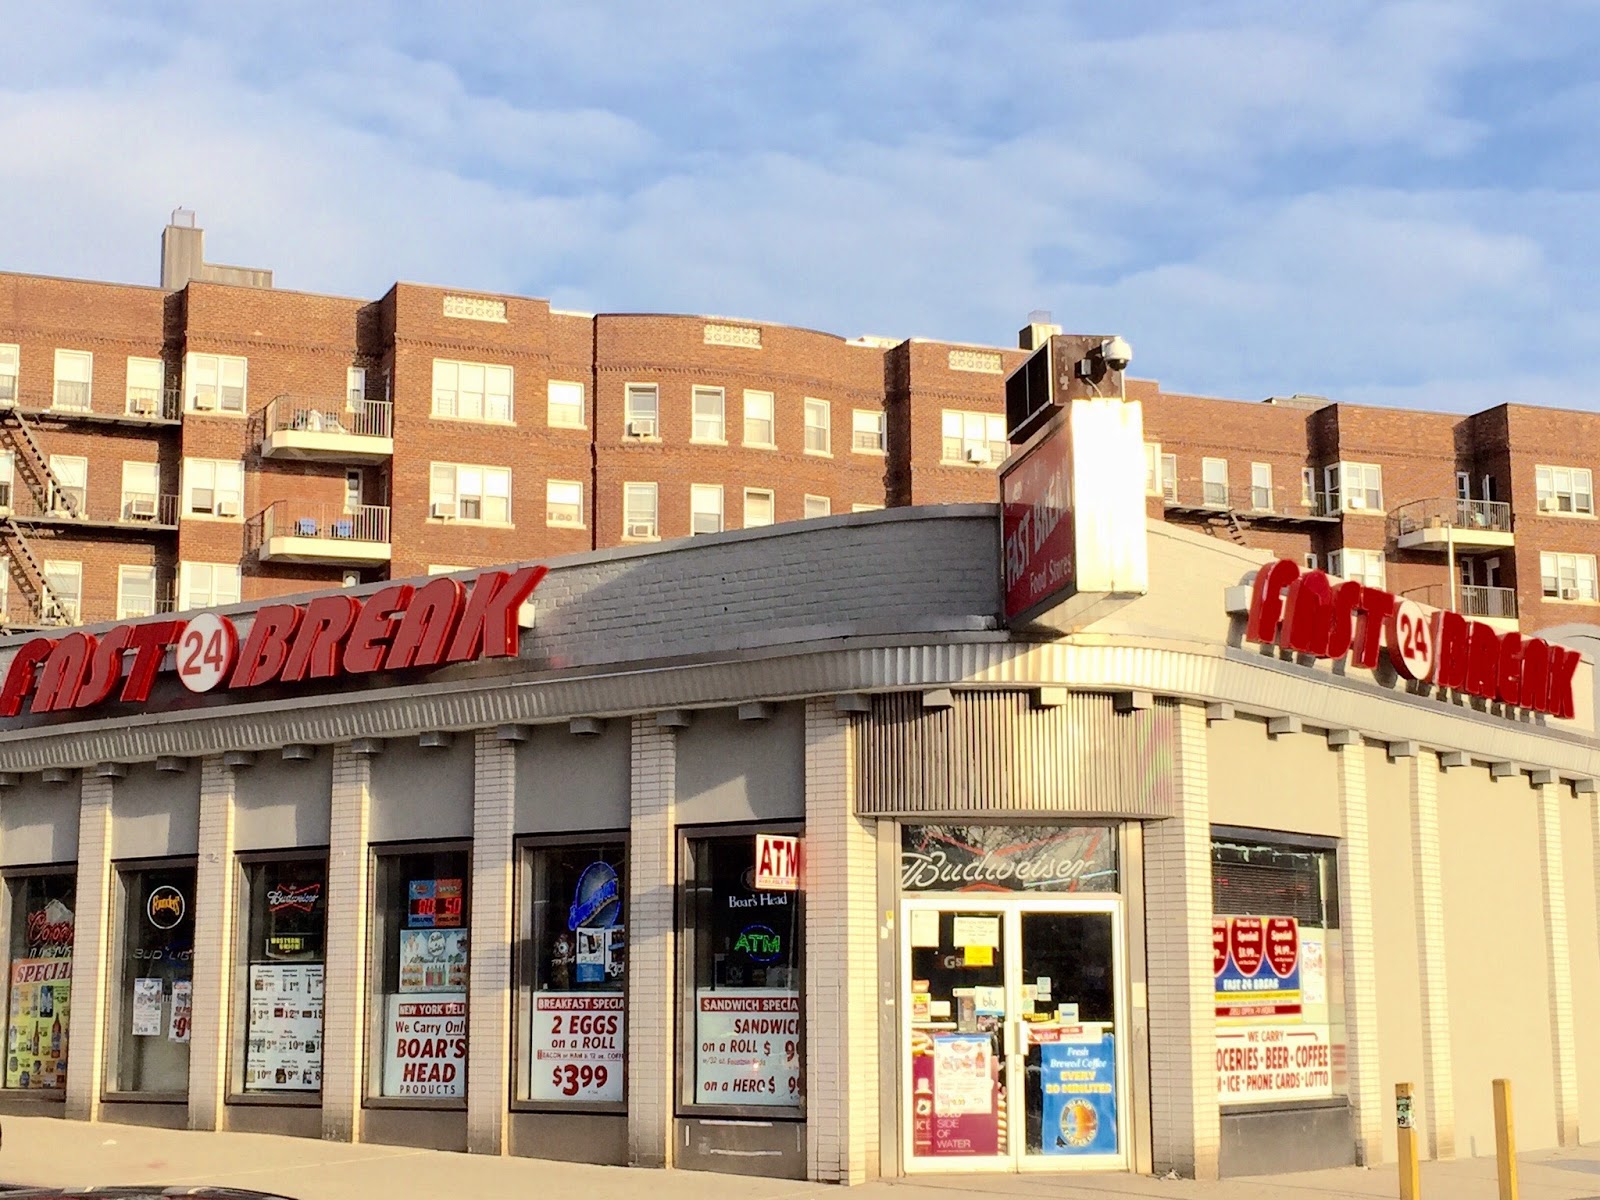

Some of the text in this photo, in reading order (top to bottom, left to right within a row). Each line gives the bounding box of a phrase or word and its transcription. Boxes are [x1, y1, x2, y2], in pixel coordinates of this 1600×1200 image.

[1007, 509, 1030, 592] FAST
[0, 565, 549, 717] FAST 24 BREAK
[1246, 559, 1581, 720] FAST 24 BREAK
[759, 839, 800, 878] ATM
[901, 849, 1094, 888] Budweiser
[728, 892, 787, 908] Boar's Head
[734, 933, 781, 953] ATM
[400, 1005, 417, 1015] NEW
[419, 1004, 443, 1015] YORK
[538, 999, 592, 1010] BREAKFAST
[703, 999, 760, 1011] SANDWICH
[396, 1020, 466, 1036] We Carry Onl
[551, 1015, 619, 1036] 2 EGGS
[551, 1036, 616, 1050] on a ROLL
[1247, 1031, 1284, 1042] WE CARRY
[396, 1038, 467, 1059] BOAR'S
[702, 1041, 716, 1053] on
[719, 1041, 726, 1053] a
[730, 1039, 758, 1053] ROLL
[1067, 1047, 1090, 1058] Fresh
[1050, 1057, 1108, 1070] Brewed Coffee
[1265, 1046, 1289, 1070] BEER
[1295, 1044, 1329, 1068] COFFEE
[402, 1063, 457, 1083] HEAD
[703, 1080, 718, 1092] on
[721, 1080, 729, 1092] a
[732, 1078, 766, 1093] HERO
[1227, 1074, 1240, 1092] ICE
[1246, 1073, 1273, 1091] PHONE
[1275, 1071, 1301, 1090] CARDS
[1305, 1070, 1329, 1088] LOTTO
[399, 1084, 456, 1095] PRODUCTS
[936, 1120, 960, 1129] SIDE
[936, 1129, 951, 1139] OF
[936, 1139, 972, 1149] WATER
